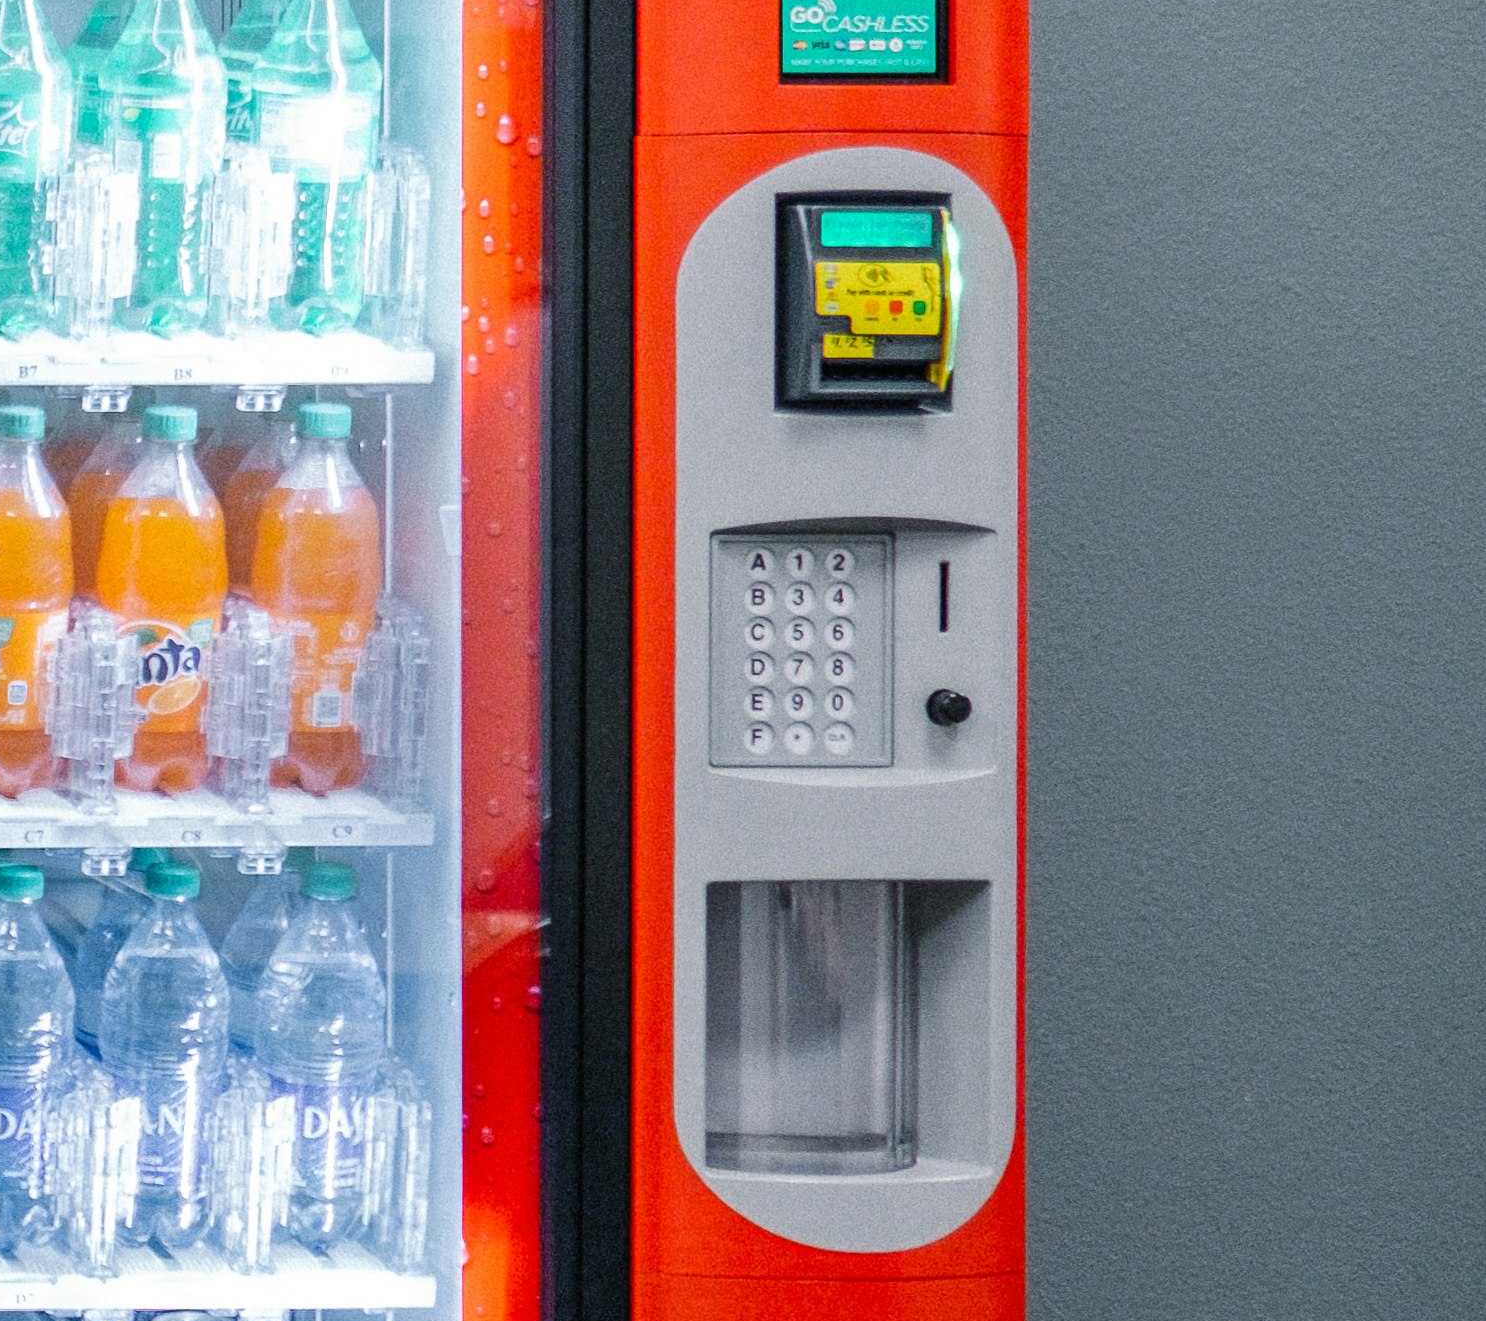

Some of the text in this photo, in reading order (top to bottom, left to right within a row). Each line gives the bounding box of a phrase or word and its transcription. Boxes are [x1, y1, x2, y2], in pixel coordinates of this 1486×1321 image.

[790, 5, 930, 33] GO CASHLESS
[18, 365, 39, 378] B7
[173, 368, 193, 380] B8
[750, 553, 766, 571] A
[794, 553, 803, 571] 1
[832, 553, 845, 572] 2
[751, 588, 765, 606] B
[793, 588, 804, 606] 3
[832, 588, 845, 606] 4
[750, 623, 765, 641] C
[794, 623, 804, 641] 5
[832, 623, 844, 642] 6
[751, 658, 766, 676] D
[794, 658, 804, 676] 7
[832, 658, 844, 677] 8
[751, 693, 763, 711] E
[792, 693, 803, 711] 9
[832, 693, 844, 711] 0
[751, 728, 764, 746] F
[23, 830, 44, 844] C7
[181, 829, 202, 843] C8
[332, 825, 353, 839] C9
